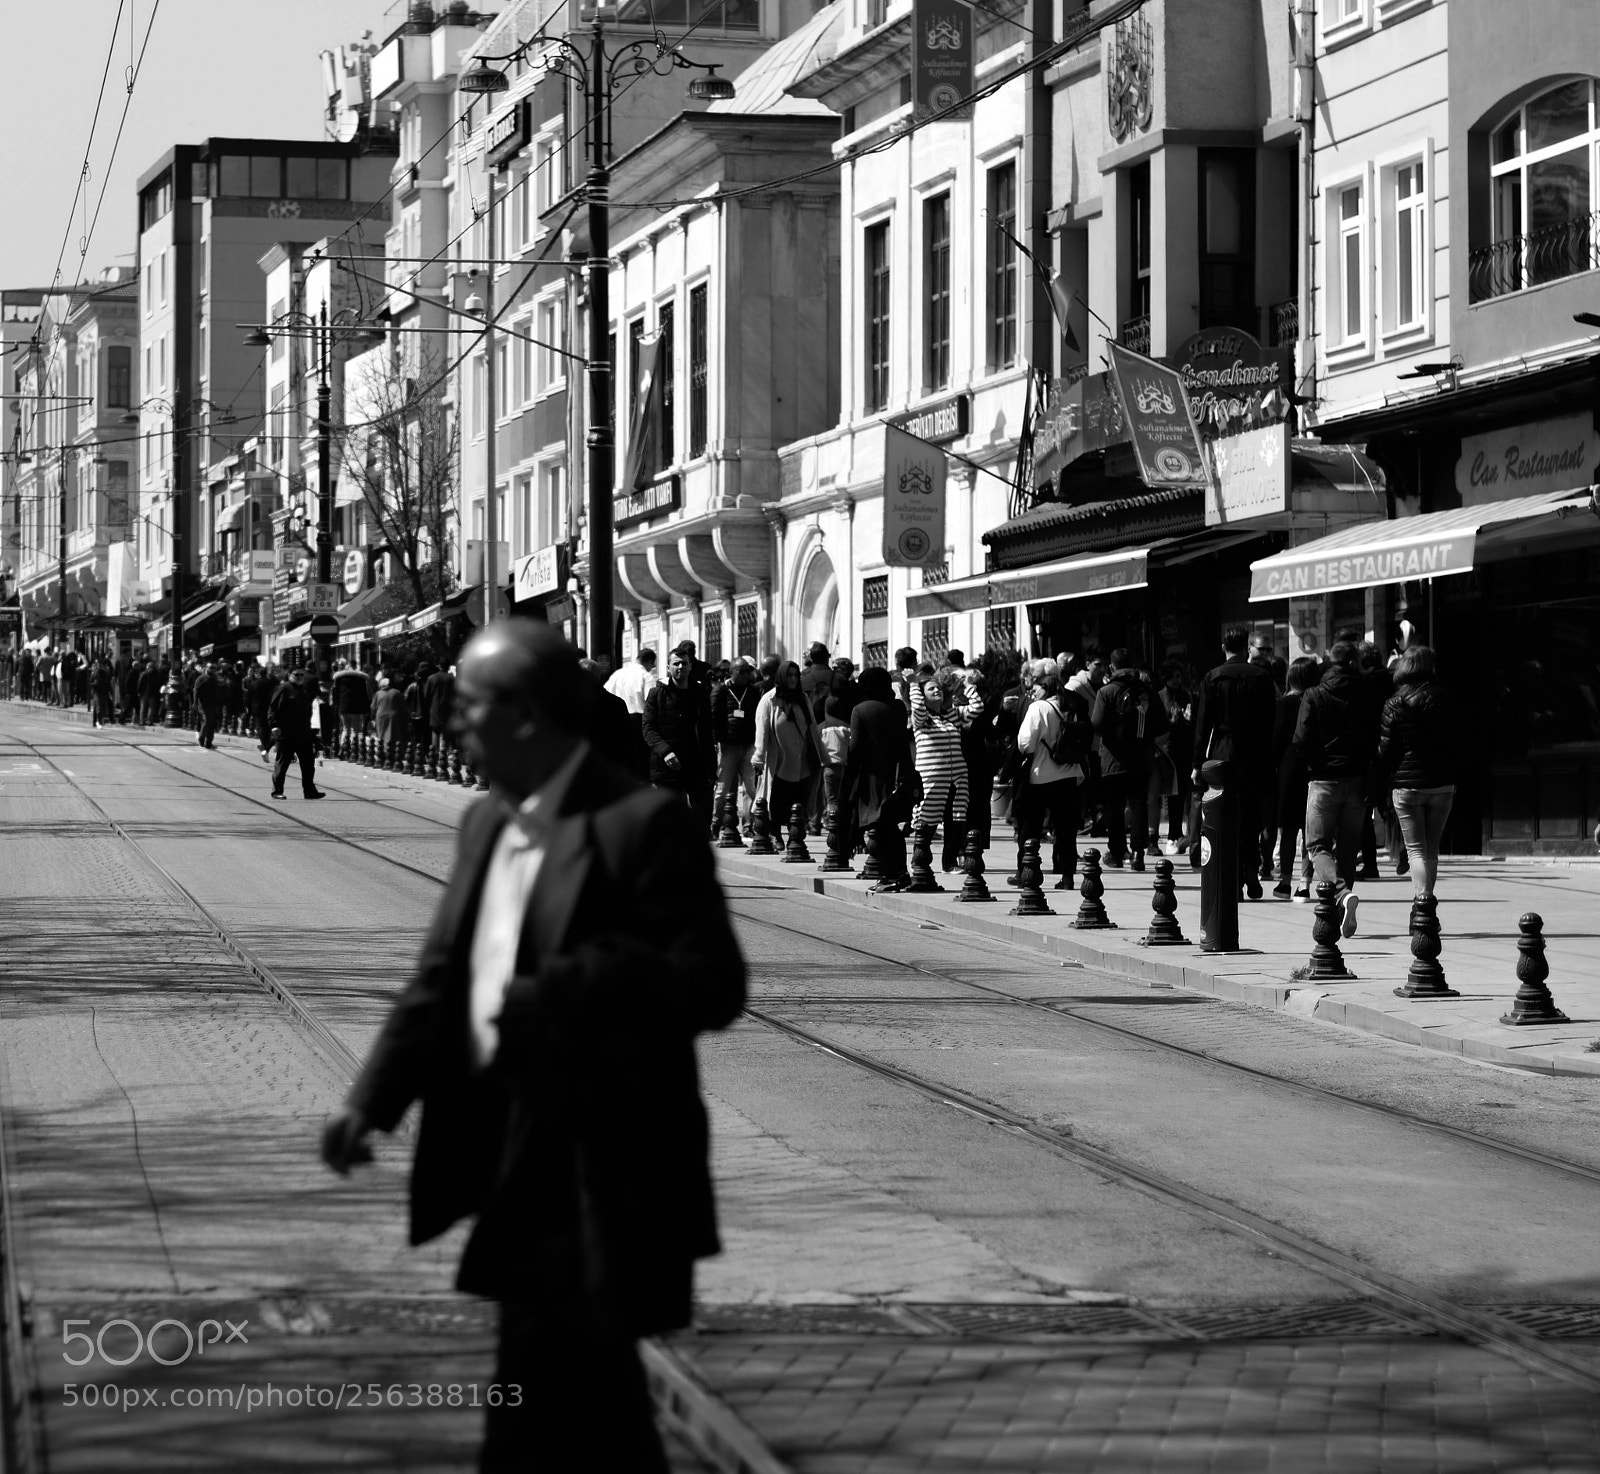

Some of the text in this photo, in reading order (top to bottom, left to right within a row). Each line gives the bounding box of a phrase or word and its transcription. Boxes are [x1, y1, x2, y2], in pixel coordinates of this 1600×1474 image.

[1181, 359, 1280, 389] ltanahmet
[1138, 423, 1188, 434] Sultanahmet
[1469, 440, 1585, 488] Can Restaurant
[1266, 543, 1453, 594] CAN RESTAURANT
